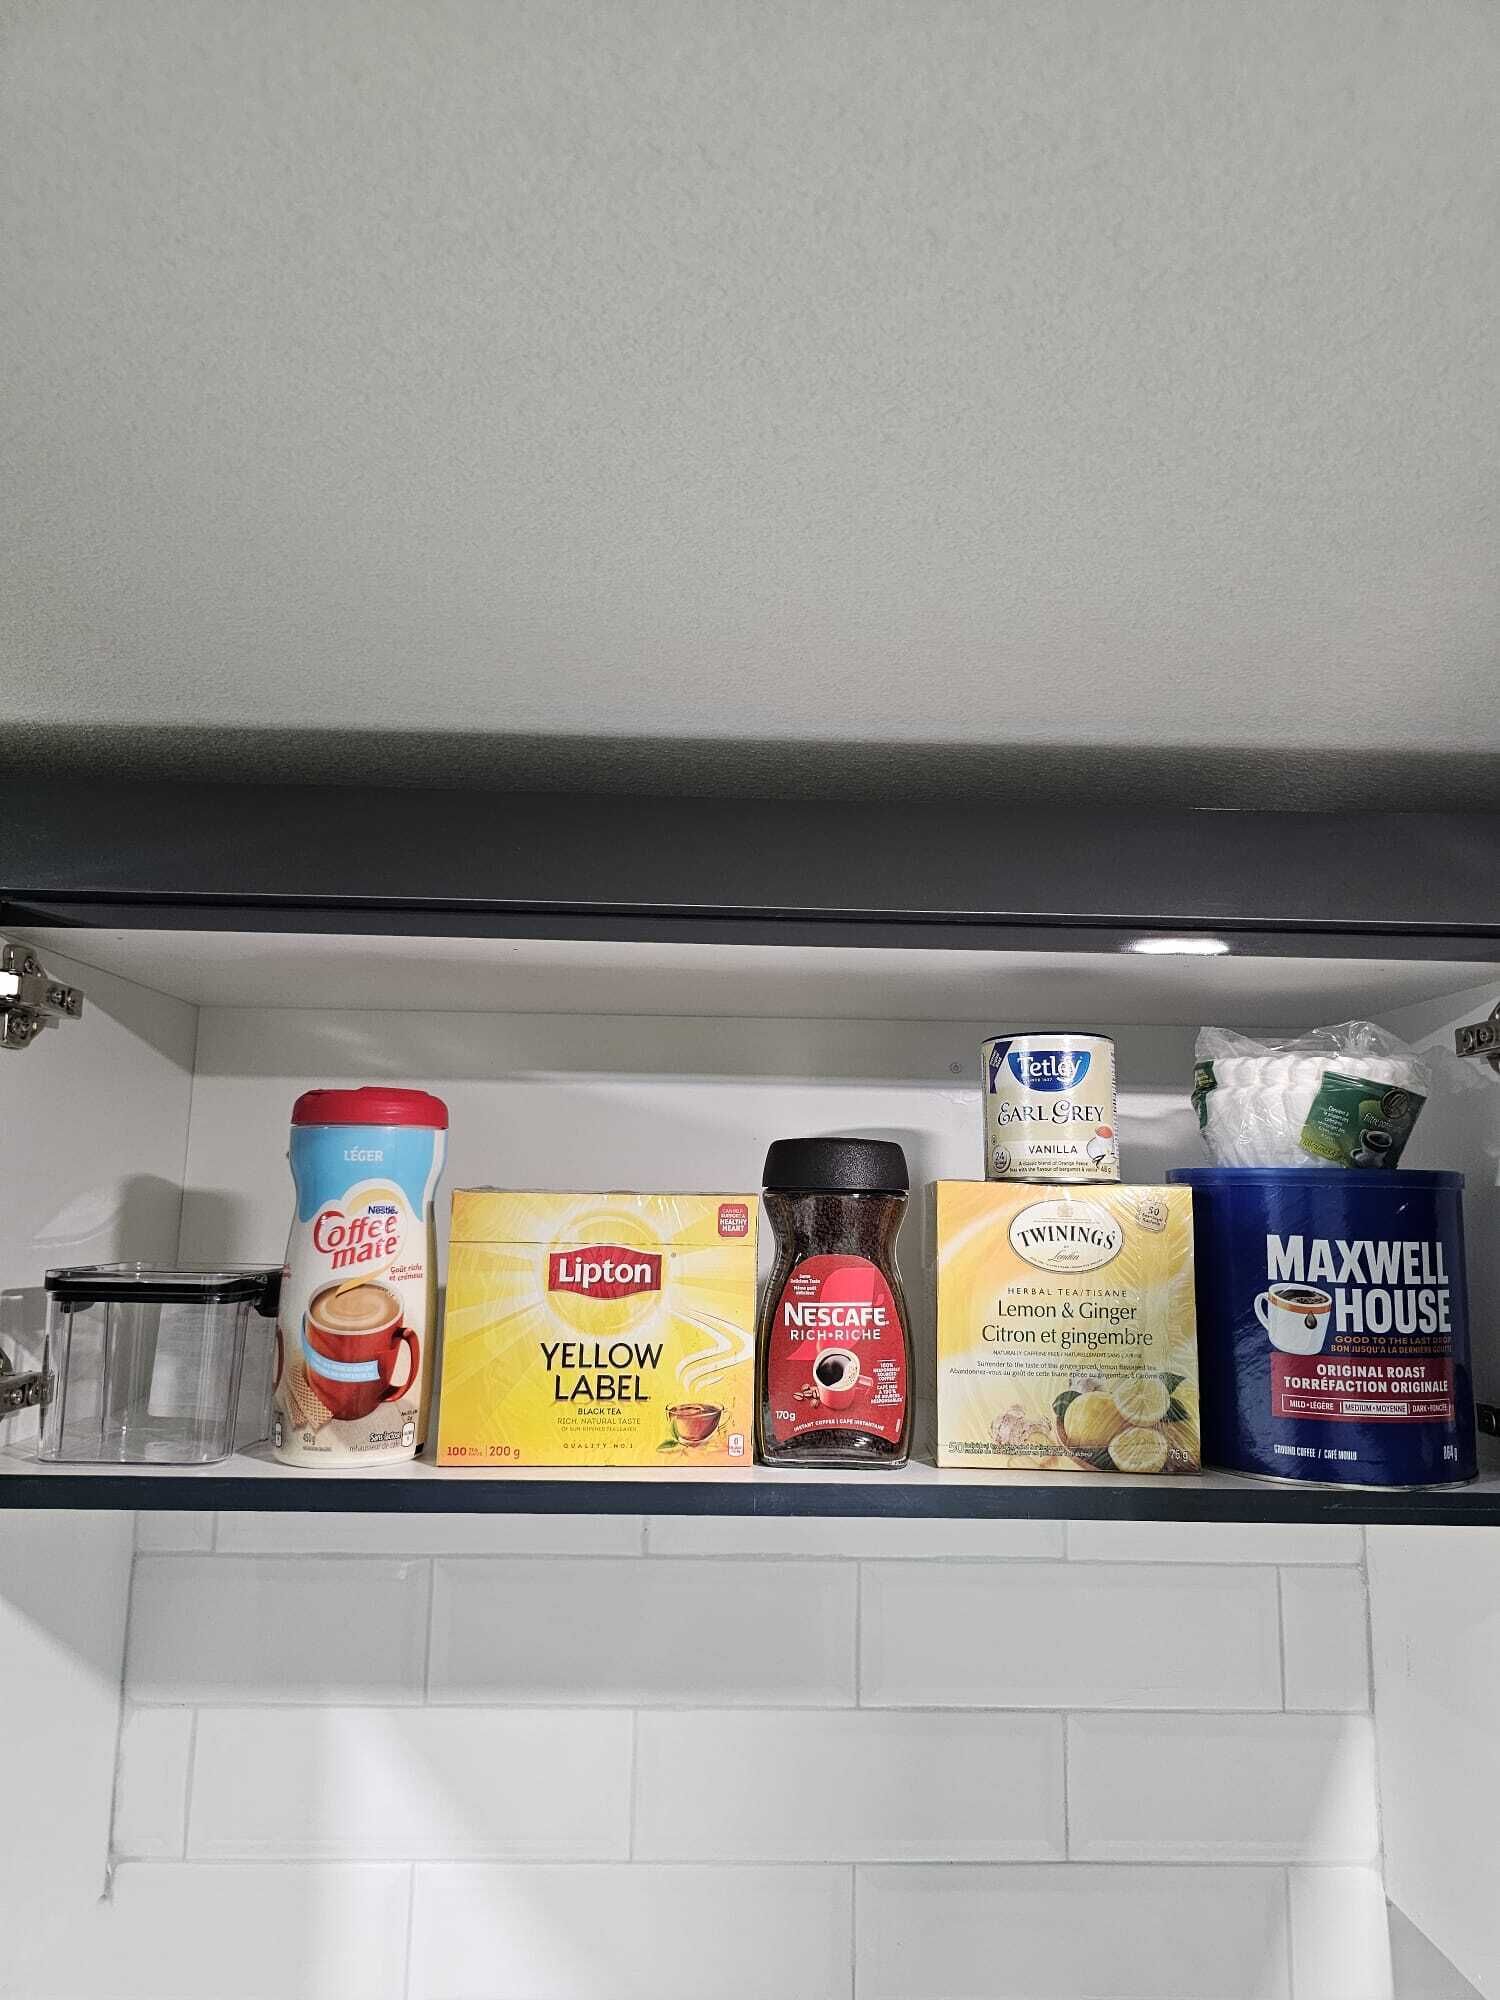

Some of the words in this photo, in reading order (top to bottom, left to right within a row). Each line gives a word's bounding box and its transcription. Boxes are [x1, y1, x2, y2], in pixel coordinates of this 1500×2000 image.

[1017, 1056, 1083, 1083] Tetley
[998, 1102, 1049, 1126] EARL
[1052, 1100, 1104, 1124] GREY
[344, 1147, 384, 1162] LÉGER
[1028, 1145, 1078, 1154] VANILLA
[720, 1218, 747, 1226] HEALTHY
[313, 1210, 397, 1254] Coffee
[1017, 1225, 1113, 1250] TWININGS
[331, 1236, 397, 1270] mate
[1266, 1234, 1449, 1285] MAXWELL
[558, 1257, 652, 1289] Lipton
[1007, 1287, 1052, 1296] HERBAL
[1059, 1288, 1127, 1298] TEA/TISANE
[998, 1300, 1056, 1318] Lemon
[1061, 1302, 1074, 1319] &
[1079, 1302, 1137, 1325] Ginger
[1335, 1288, 1452, 1334] HOUSE
[982, 1325, 1036, 1342] Citron
[1040, 1328, 1057, 1343] et
[1061, 1327, 1153, 1350] gingembre
[1372, 1336, 1386, 1344] TO
[1388, 1336, 1408, 1344] THE
[1410, 1336, 1430, 1344] LAST
[540, 1342, 664, 1371] YELLOW
[1388, 1346, 1397, 1354] LA
[1316, 1364, 1384, 1378] ORIGINAL
[1387, 1365, 1426, 1379] ROAST
[554, 1374, 647, 1402] LABEL
[1283, 1375, 1386, 1393] TORRÉFACTION
[1391, 1380, 1448, 1393] ORIGINALE
[581, 1417, 616, 1425] NATURAL
[794, 1422, 814, 1432] INSTANT
[448, 1446, 467, 1456] 100
[490, 1446, 510, 1456] 200
[513, 1448, 520, 1460] g
[1273, 1444, 1296, 1456] GROUND
[1296, 1446, 1316, 1458] COFFEE
[1324, 1448, 1338, 1460] CAFÉ
